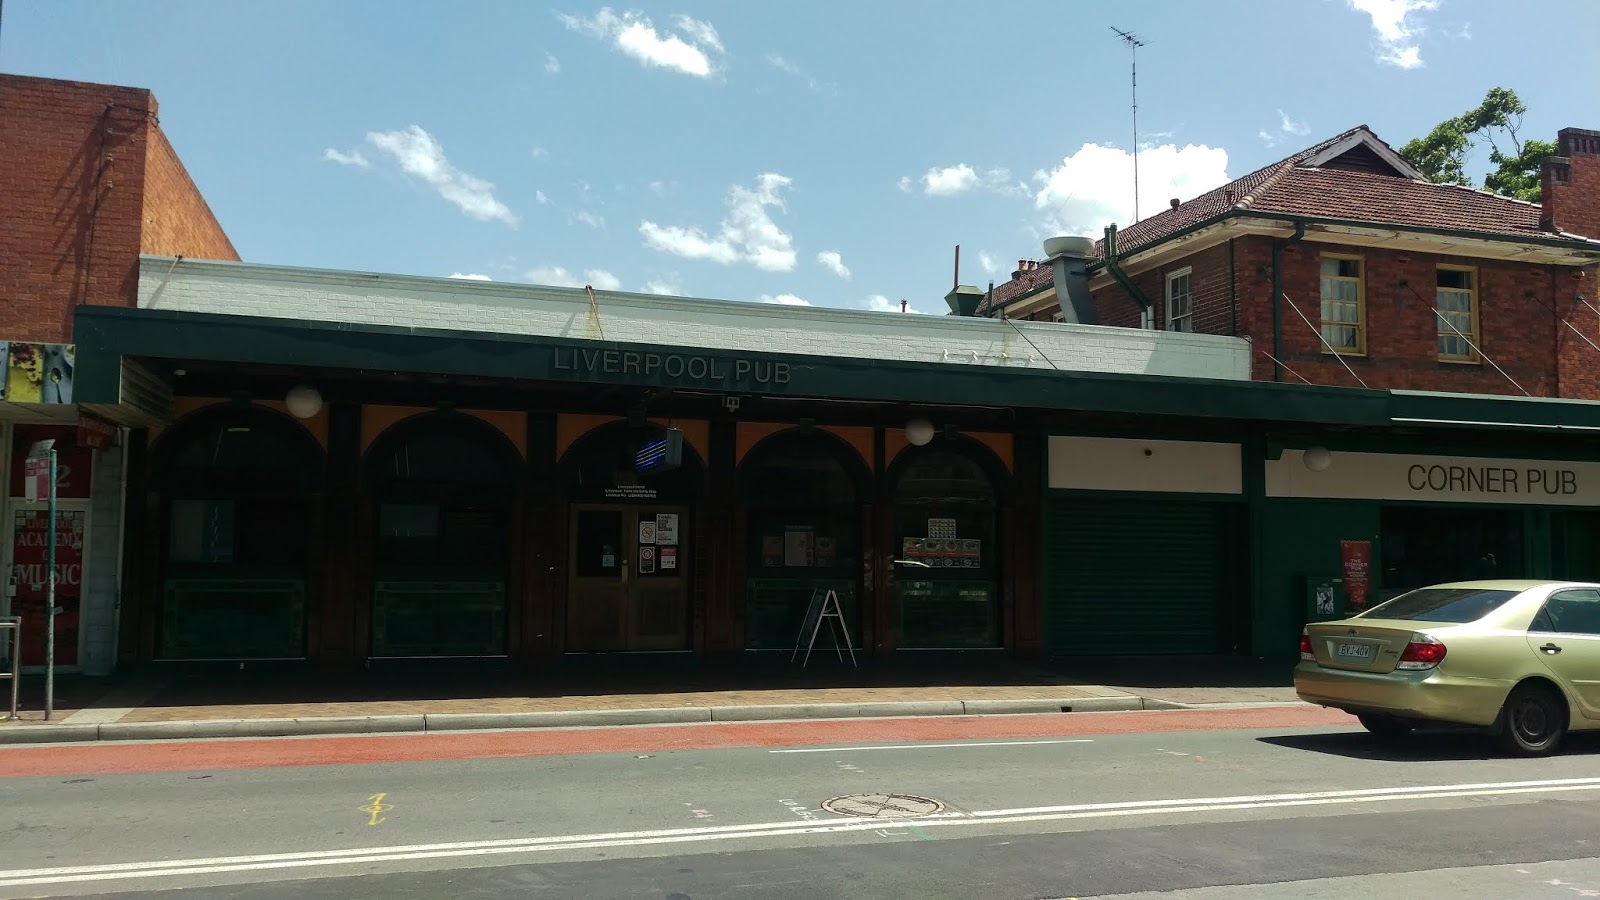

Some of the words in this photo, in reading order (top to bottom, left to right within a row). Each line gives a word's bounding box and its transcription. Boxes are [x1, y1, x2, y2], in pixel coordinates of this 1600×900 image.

[554, 347, 726, 379] LIVERPOOL
[735, 359, 793, 384] PUB
[1407, 464, 1519, 493] CORNER
[1527, 469, 1578, 495] PUB
[17, 532, 81, 547] ACAEMY
[16, 563, 81, 585] MUSIC
